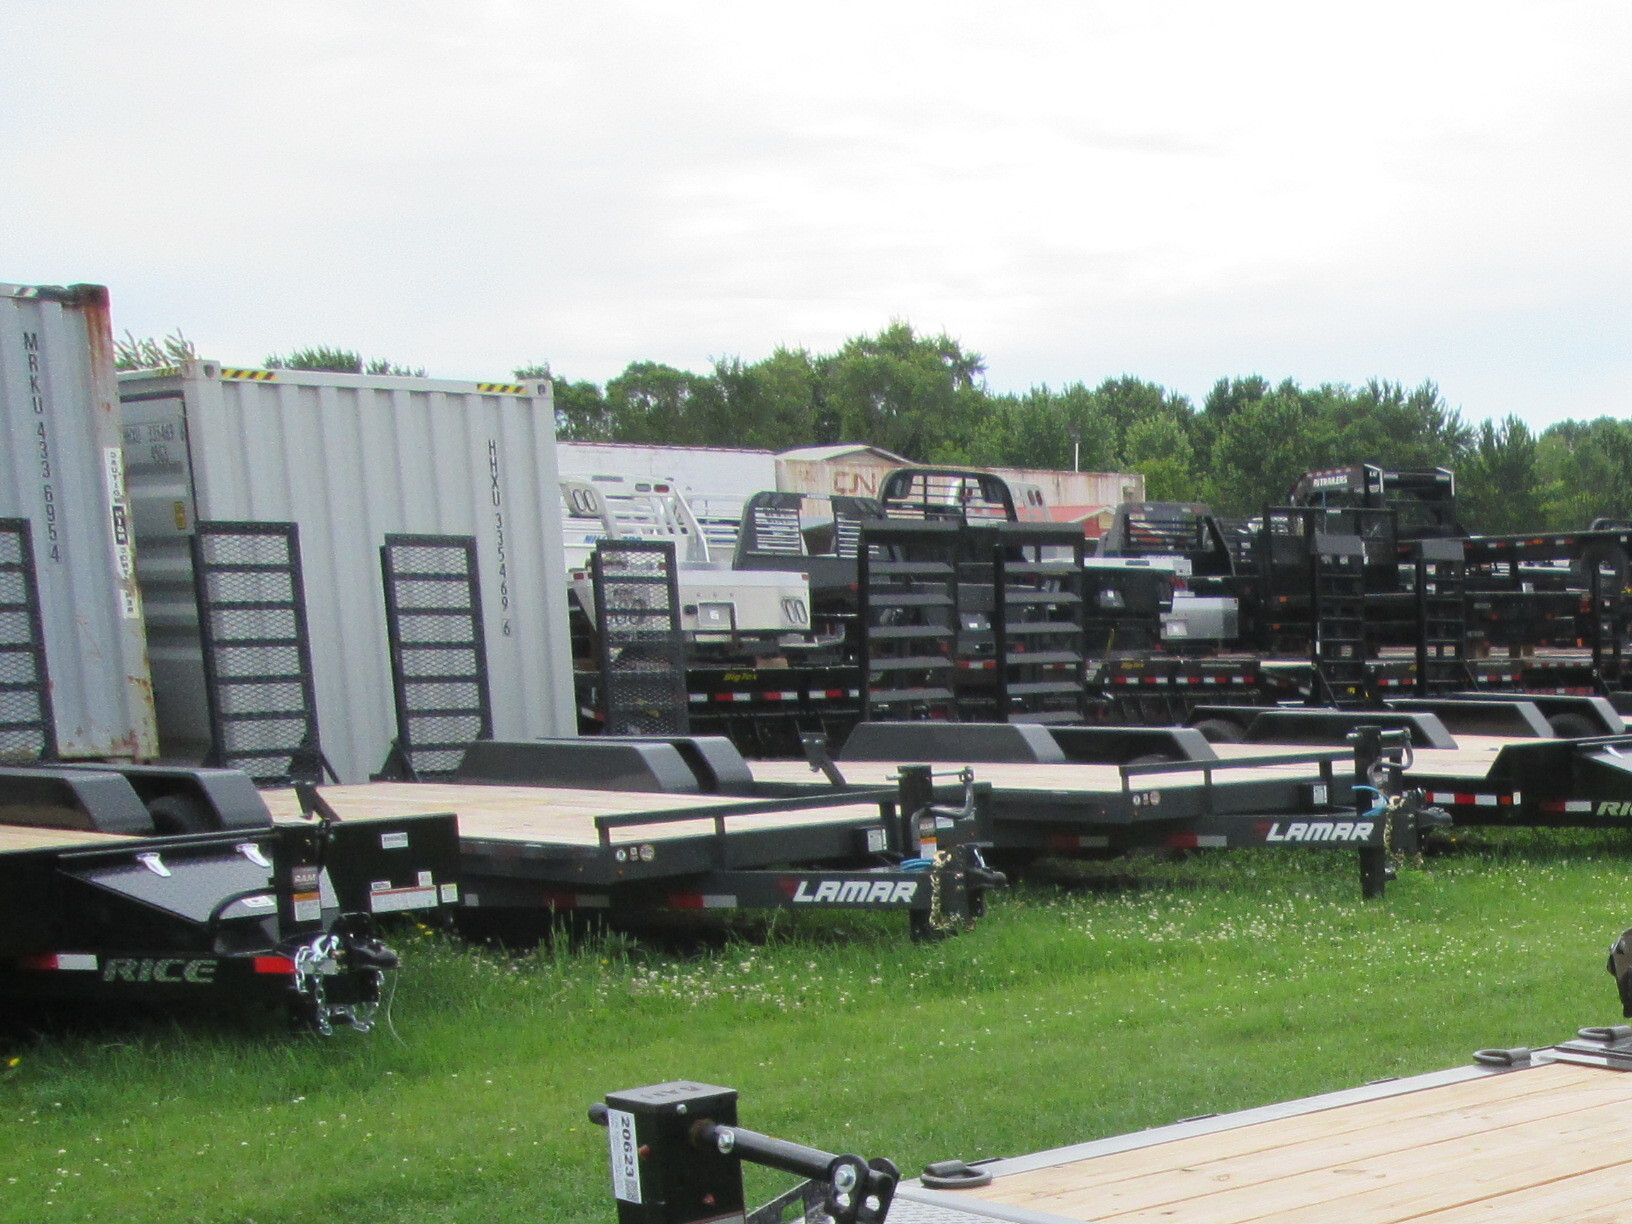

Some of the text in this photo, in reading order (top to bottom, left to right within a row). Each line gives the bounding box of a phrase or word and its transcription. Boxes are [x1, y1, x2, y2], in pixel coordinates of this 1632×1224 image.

[23, 331, 43, 414] MRKU
[488, 439, 500, 506] HHXU
[834, 471, 877, 494] CN
[1266, 822, 1374, 842] LAMAR
[793, 881, 918, 902] LAMAR
[103, 959, 218, 982] RICE
[621, 1116, 635, 1178] 20623
